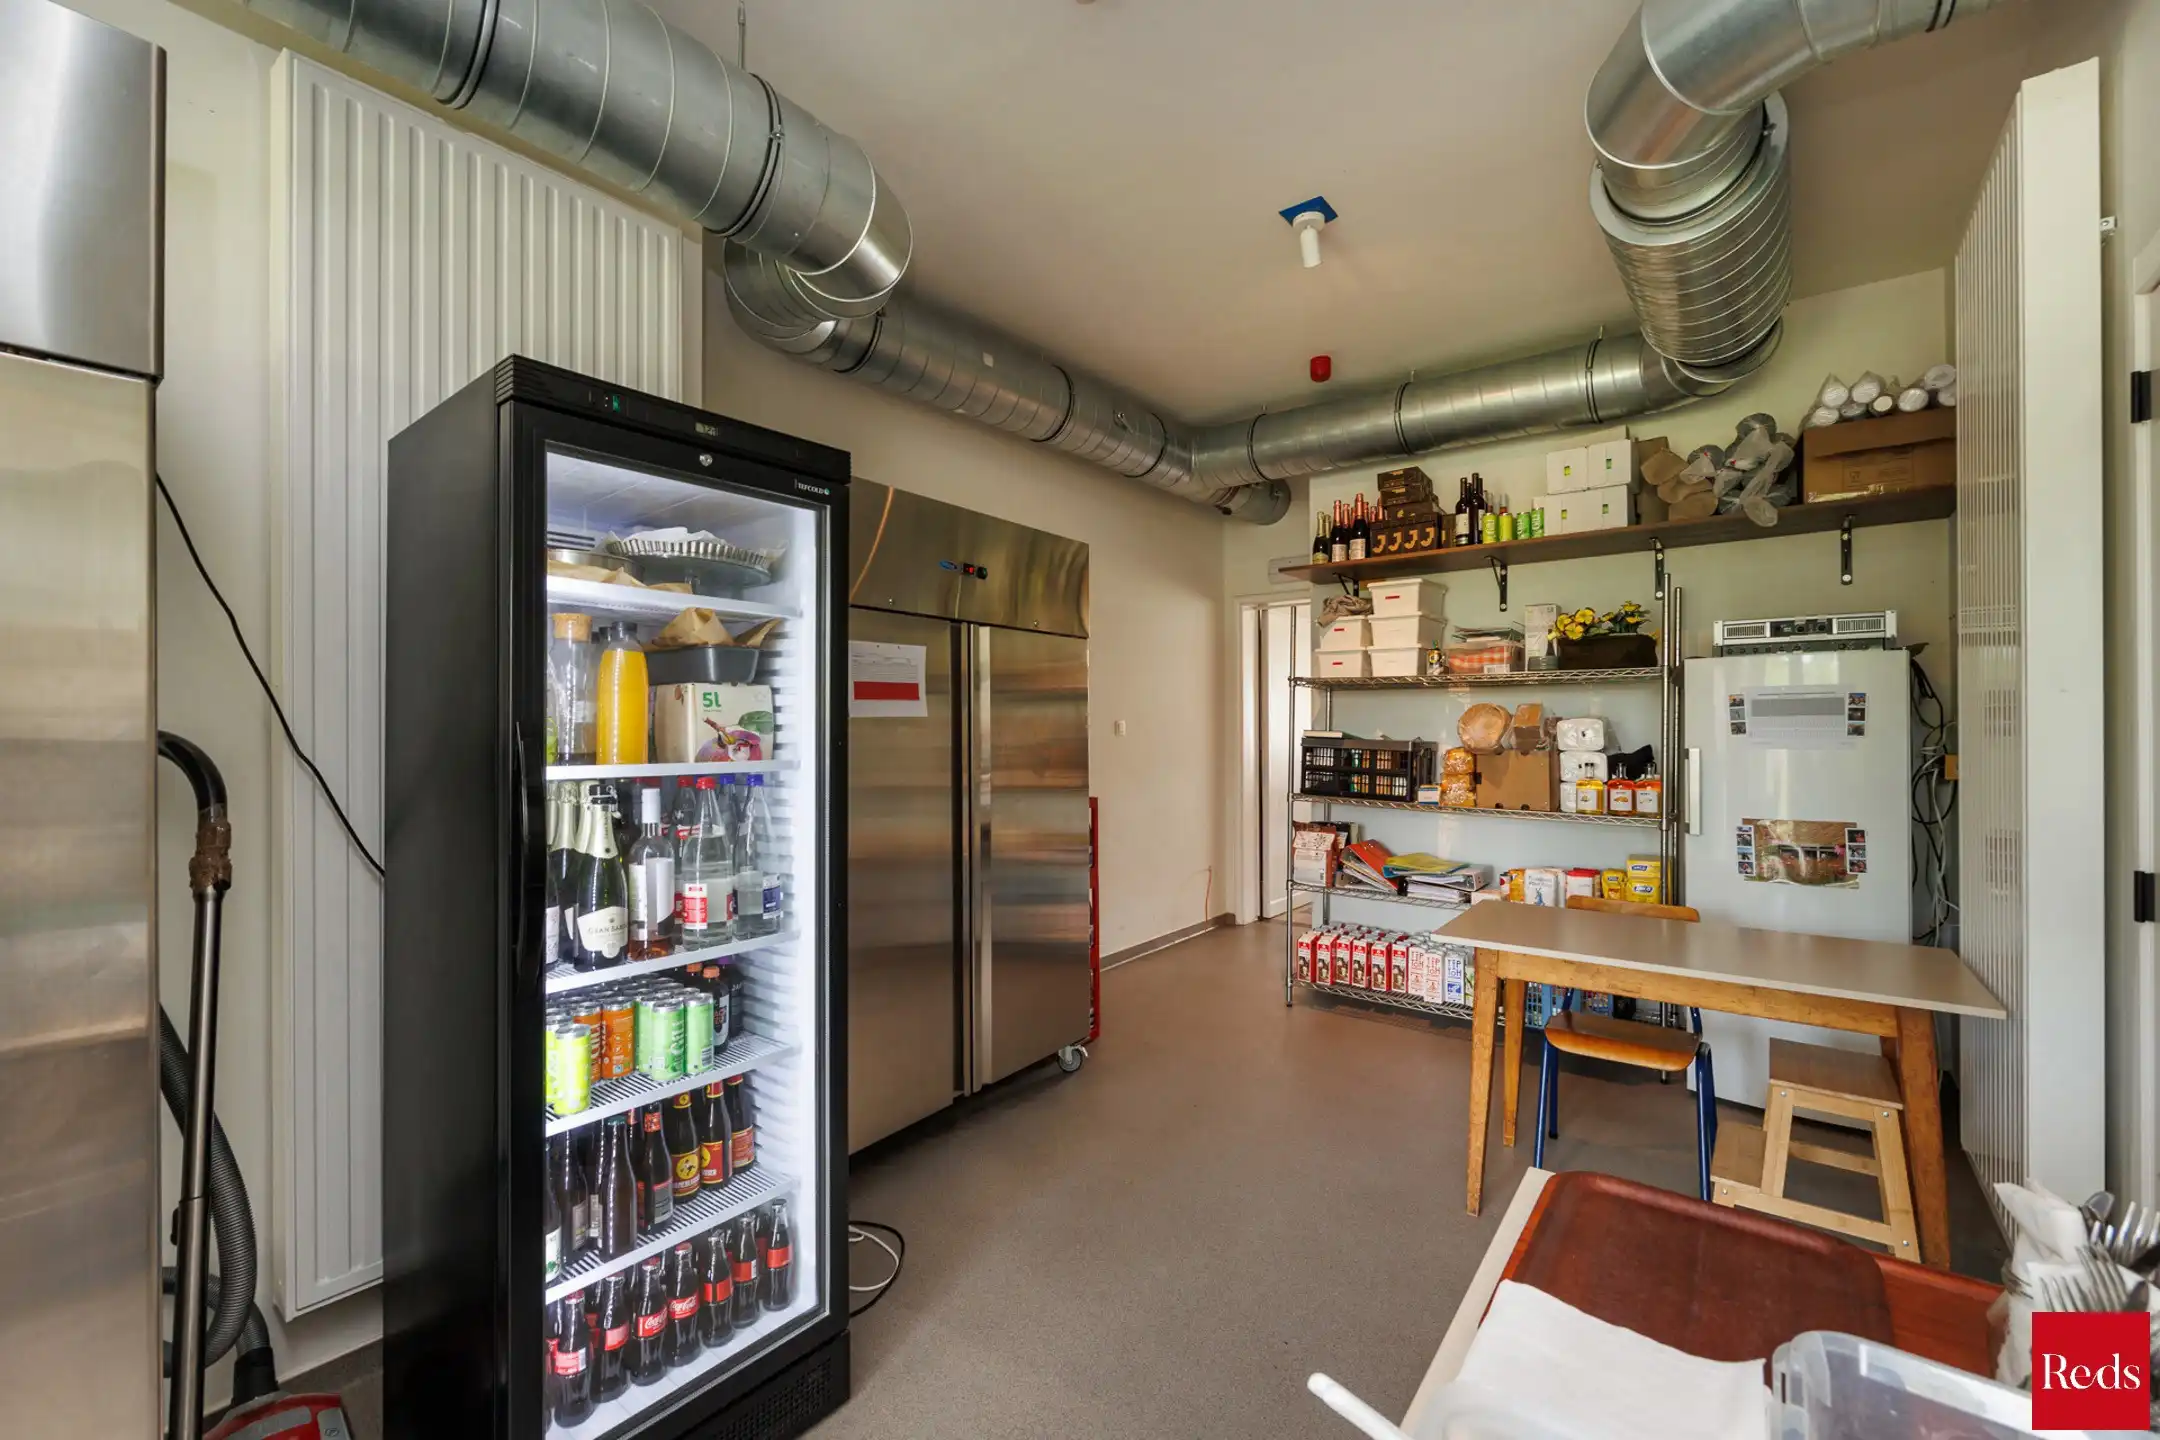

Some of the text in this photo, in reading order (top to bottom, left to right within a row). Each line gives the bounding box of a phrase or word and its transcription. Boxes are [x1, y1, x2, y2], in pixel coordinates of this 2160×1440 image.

[1372, 527, 1435, 553] J J J J
